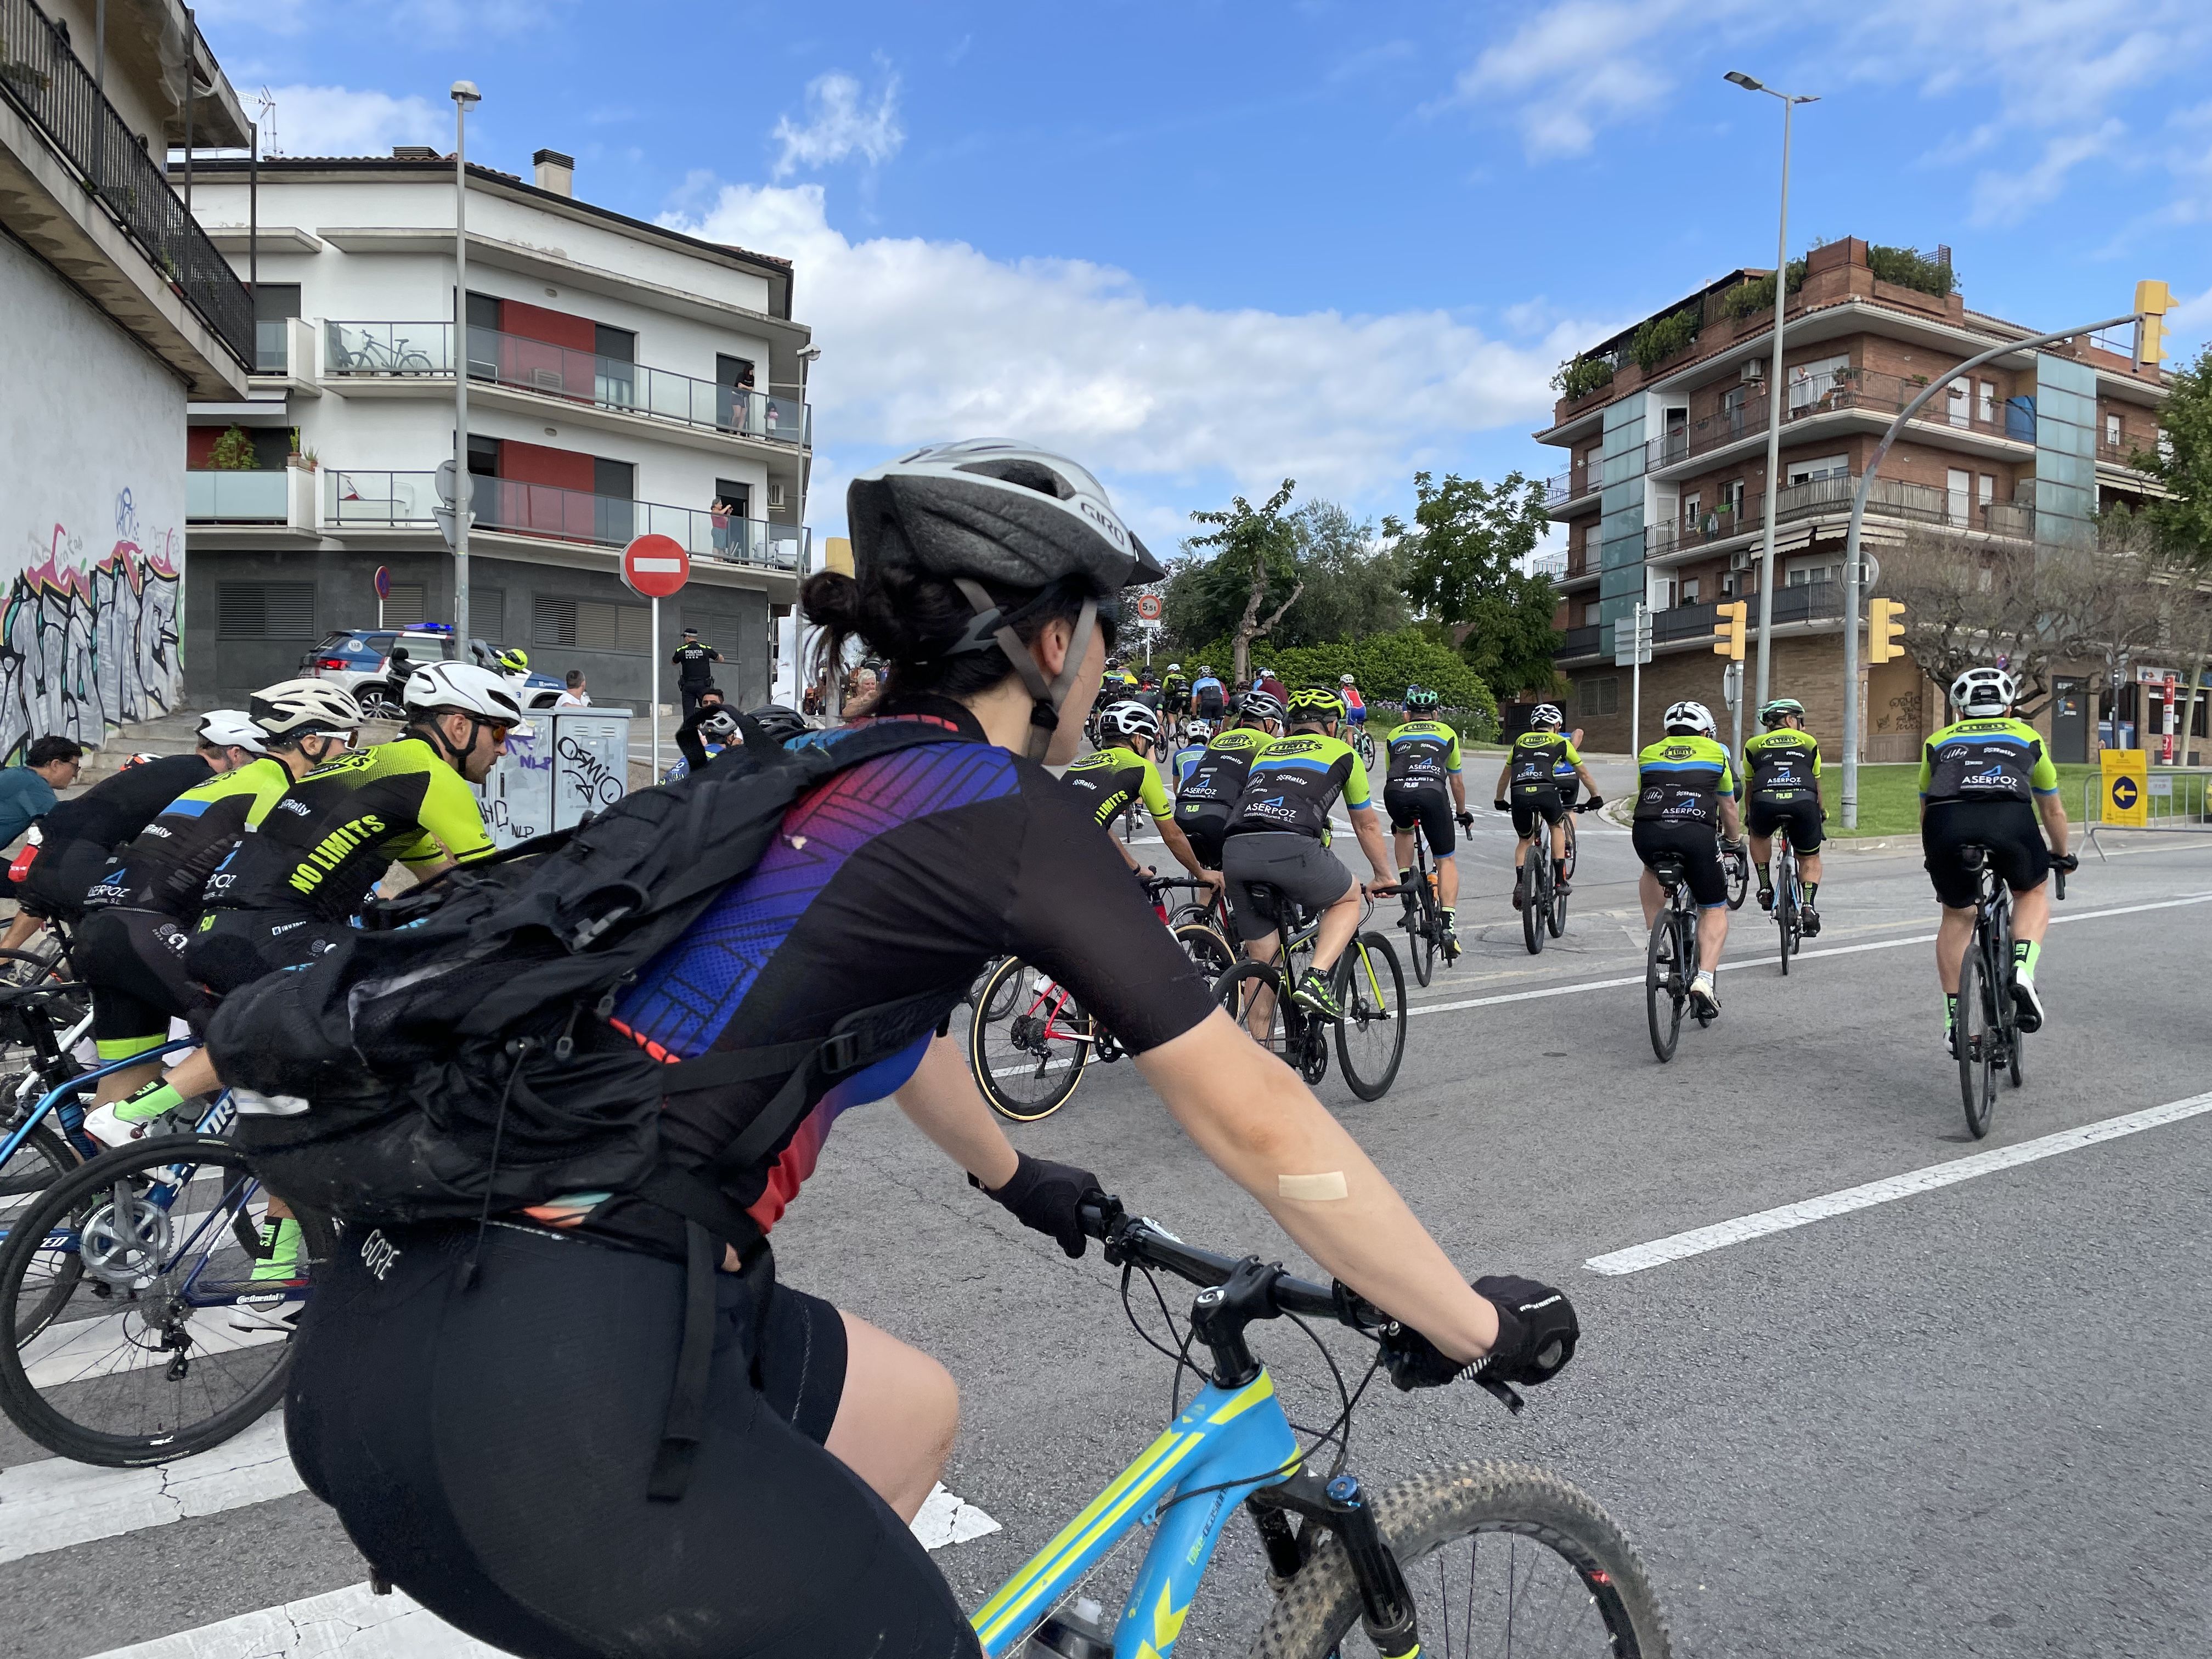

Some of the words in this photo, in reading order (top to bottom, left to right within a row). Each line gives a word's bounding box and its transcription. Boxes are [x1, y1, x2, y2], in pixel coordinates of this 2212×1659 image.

[1080, 502, 1124, 546] GIRO
[520, 755, 552, 770] NLP
[1408, 764, 1441, 773] ASERPOZ
[1080, 779, 1097, 790] Rally
[1285, 774, 1308, 785] Rally
[1961, 775, 2018, 787] ASERPOZ
[1183, 787, 1217, 795] ASERPOZ
[287, 799, 312, 816] Rally
[1096, 790, 1128, 820] LIMITS
[1244, 803, 1297, 817] ASERPOZ
[1662, 808, 1706, 819] ASERPOZ
[146, 824, 172, 838] Rally
[511, 823, 534, 838] NLP
[288, 863, 323, 895] NO
[307, 815, 386, 871] LIMITS
[361, 1229, 400, 1280] GORE
[236, 1293, 279, 1305] Continental
